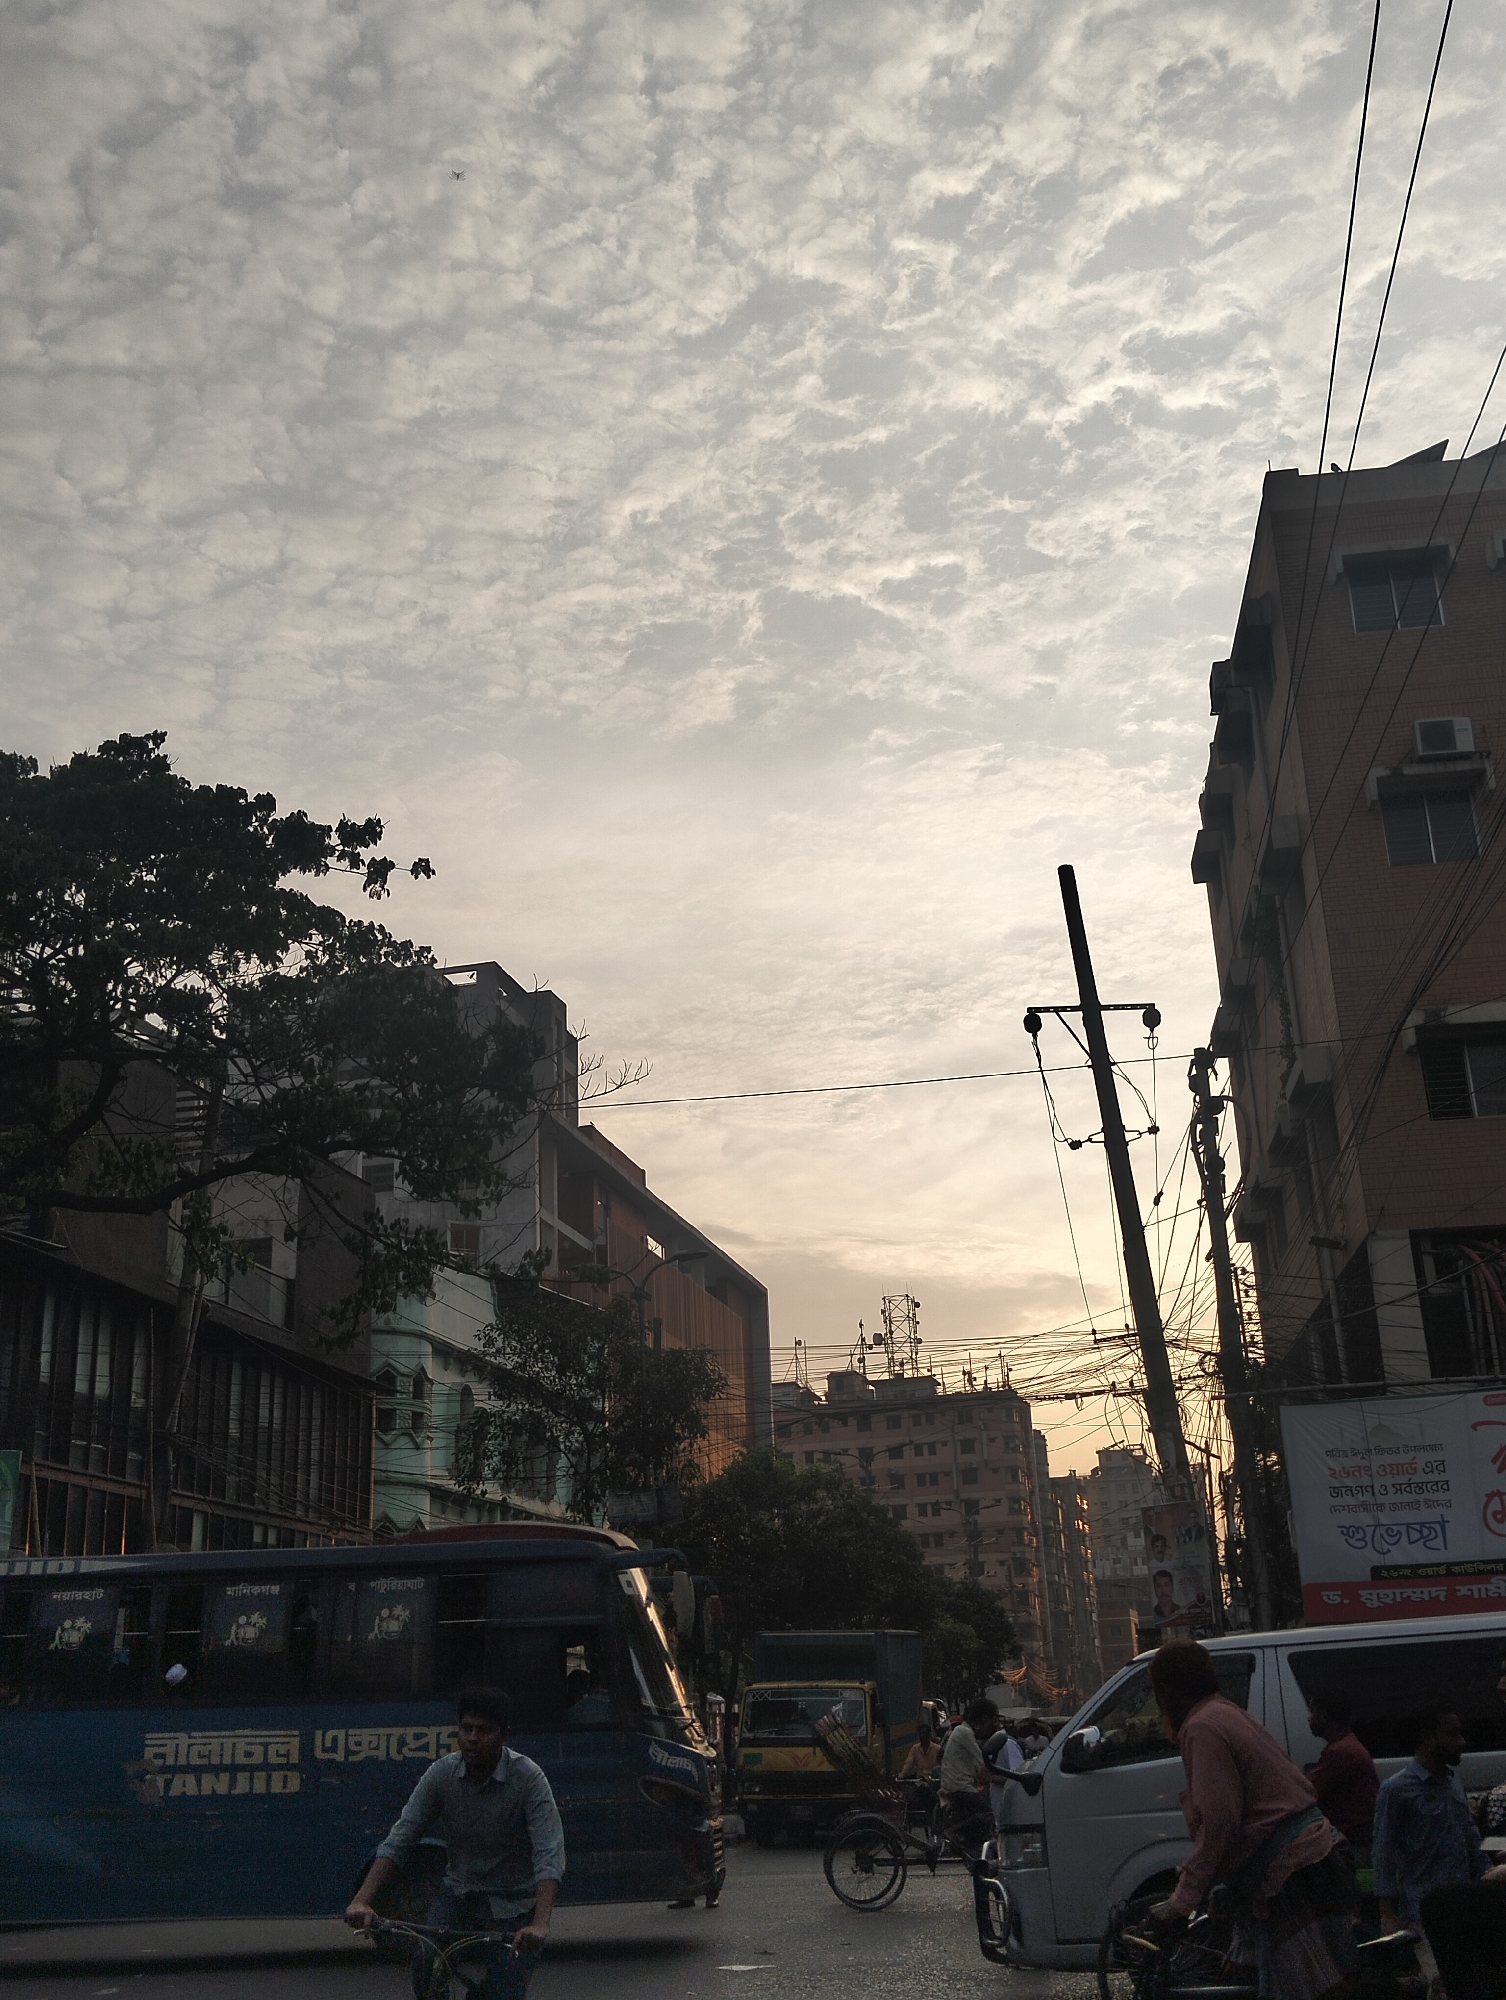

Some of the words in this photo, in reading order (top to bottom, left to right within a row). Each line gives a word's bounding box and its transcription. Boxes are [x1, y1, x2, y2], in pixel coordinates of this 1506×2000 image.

[1328, 1465, 1372, 1479] ২৬নং
[1377, 1456, 1418, 1478] ওয়ার্ড
[1423, 1460, 1446, 1475] এর
[1329, 1484, 1375, 1498] জনগণ
[1378, 1484, 1389, 1496] ও
[1391, 1478, 1450, 1494] সর্বস্তরের
[1330, 1501, 1387, 1515] দেশবাসীকে
[1388, 1499, 1421, 1512] জানাই
[1422, 1498, 1452, 1510] ঈদের
[1337, 1514, 1450, 1555] শুভেচ্ছা
[1417, 1564, 1447, 1576] ওয়ার্ড
[1321, 1590, 1350, 1605] ড.
[143, 1729, 301, 1766] নীলাচল
